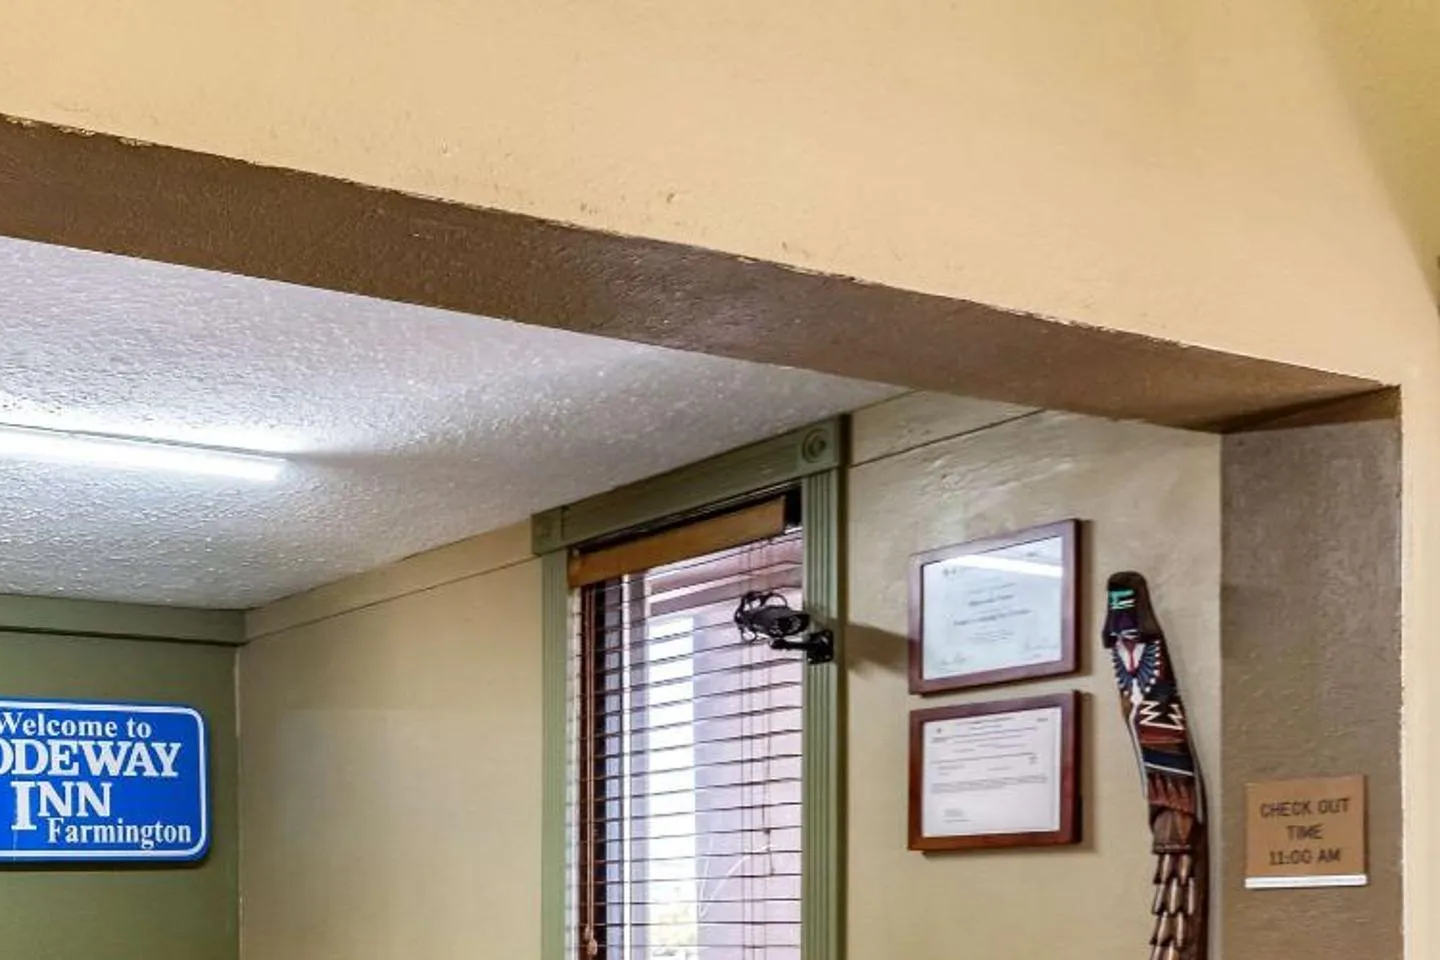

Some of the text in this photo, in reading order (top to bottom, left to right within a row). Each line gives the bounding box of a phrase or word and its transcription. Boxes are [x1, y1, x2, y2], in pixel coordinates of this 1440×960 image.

[127, 716, 152, 738] to
[10, 781, 112, 831] INN
[1260, 797, 1351, 817] CHECK OUT
[46, 817, 192, 849] Farmington
[1286, 823, 1324, 840] TIME
[1318, 848, 1342, 863] AM
